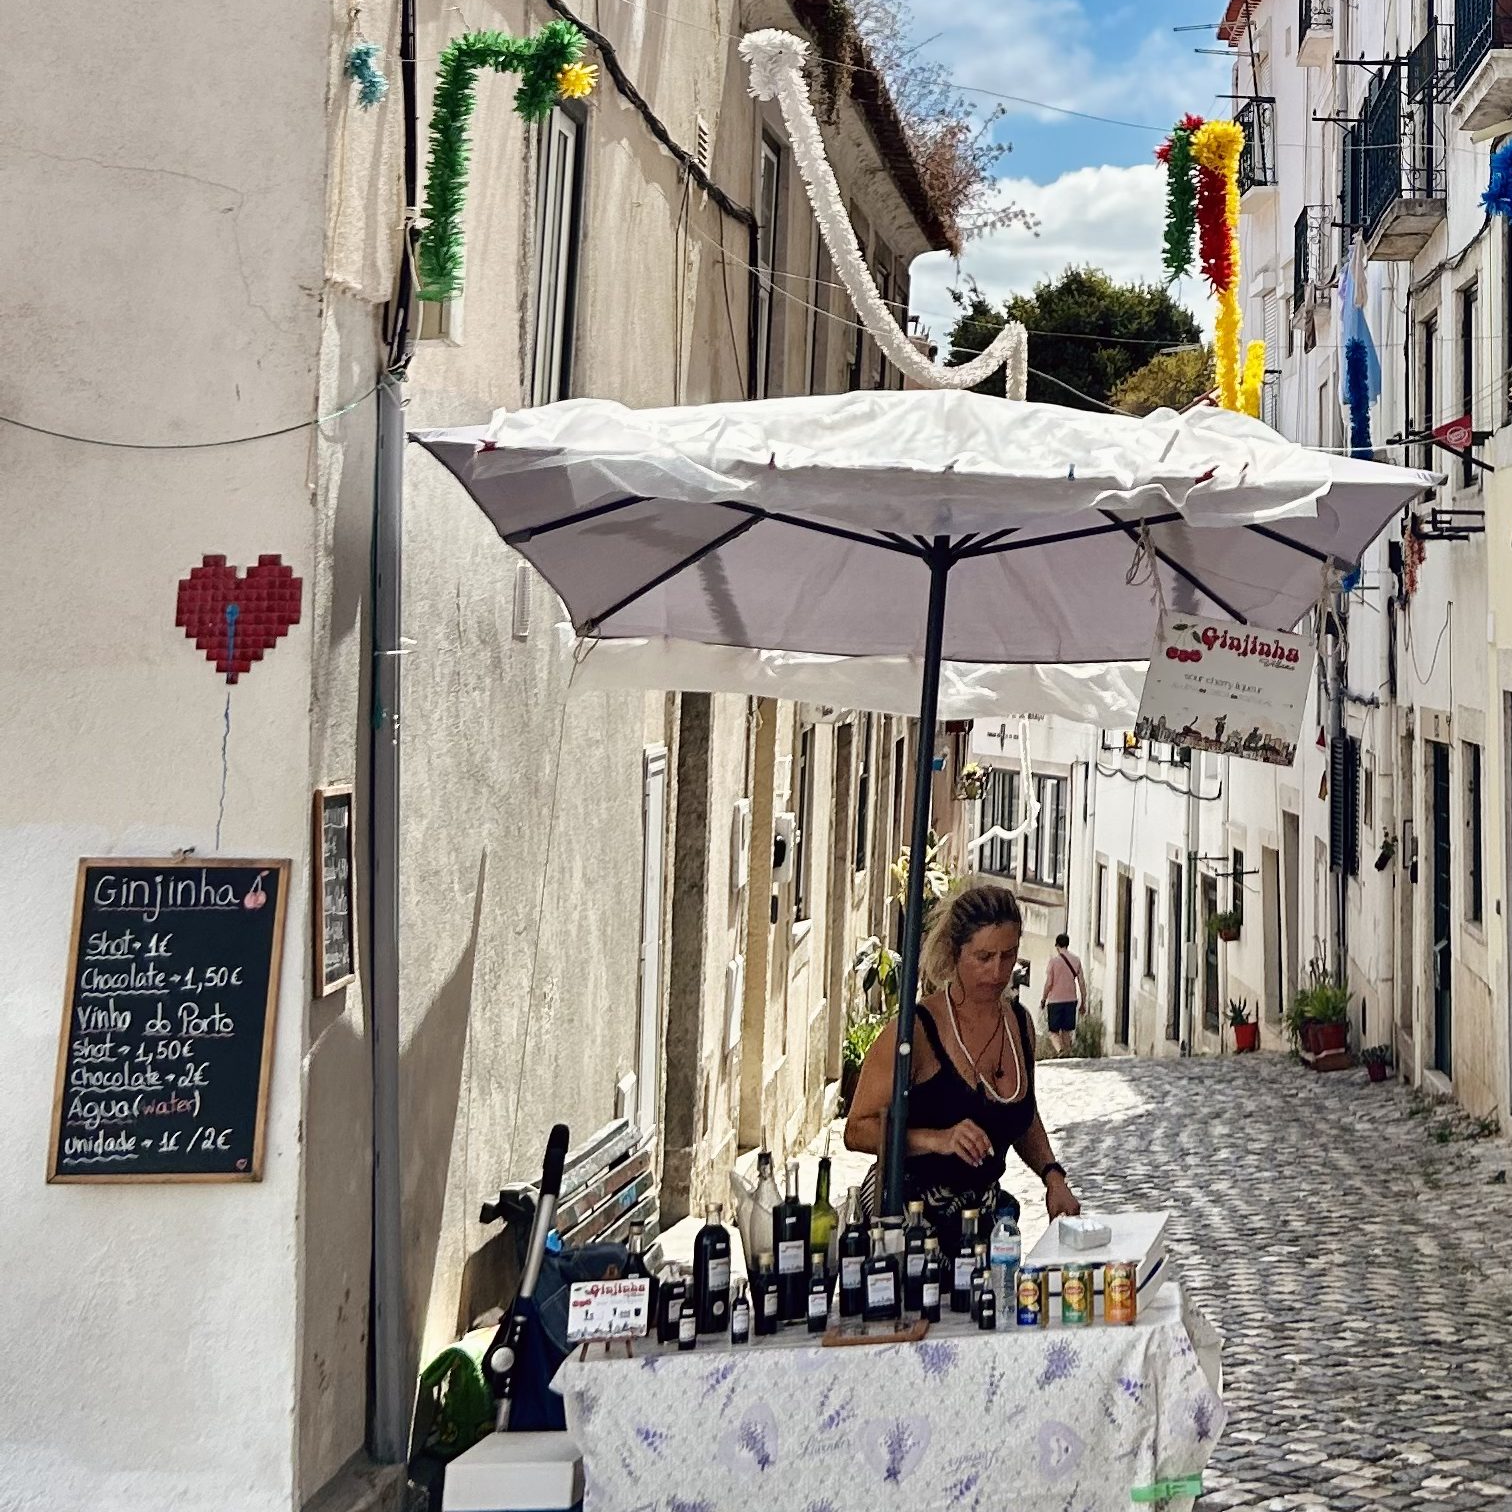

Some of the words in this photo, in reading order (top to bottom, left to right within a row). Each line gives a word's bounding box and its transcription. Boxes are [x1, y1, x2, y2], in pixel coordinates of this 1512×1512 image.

[1201, 626, 1300, 664] Ginjinha
[94, 868, 240, 923] Ginjinha
[86, 928, 136, 956] Shot
[144, 933, 174, 957] 1€
[81, 962, 167, 991] Chocolate
[77, 998, 132, 1031] Vinho
[145, 1001, 171, 1034] do
[177, 1002, 235, 1035] Porto
[134, 1039, 195, 1065] 1,50€
[71, 1061, 163, 1087] Chocolate
[177, 1062, 210, 1088] 2€
